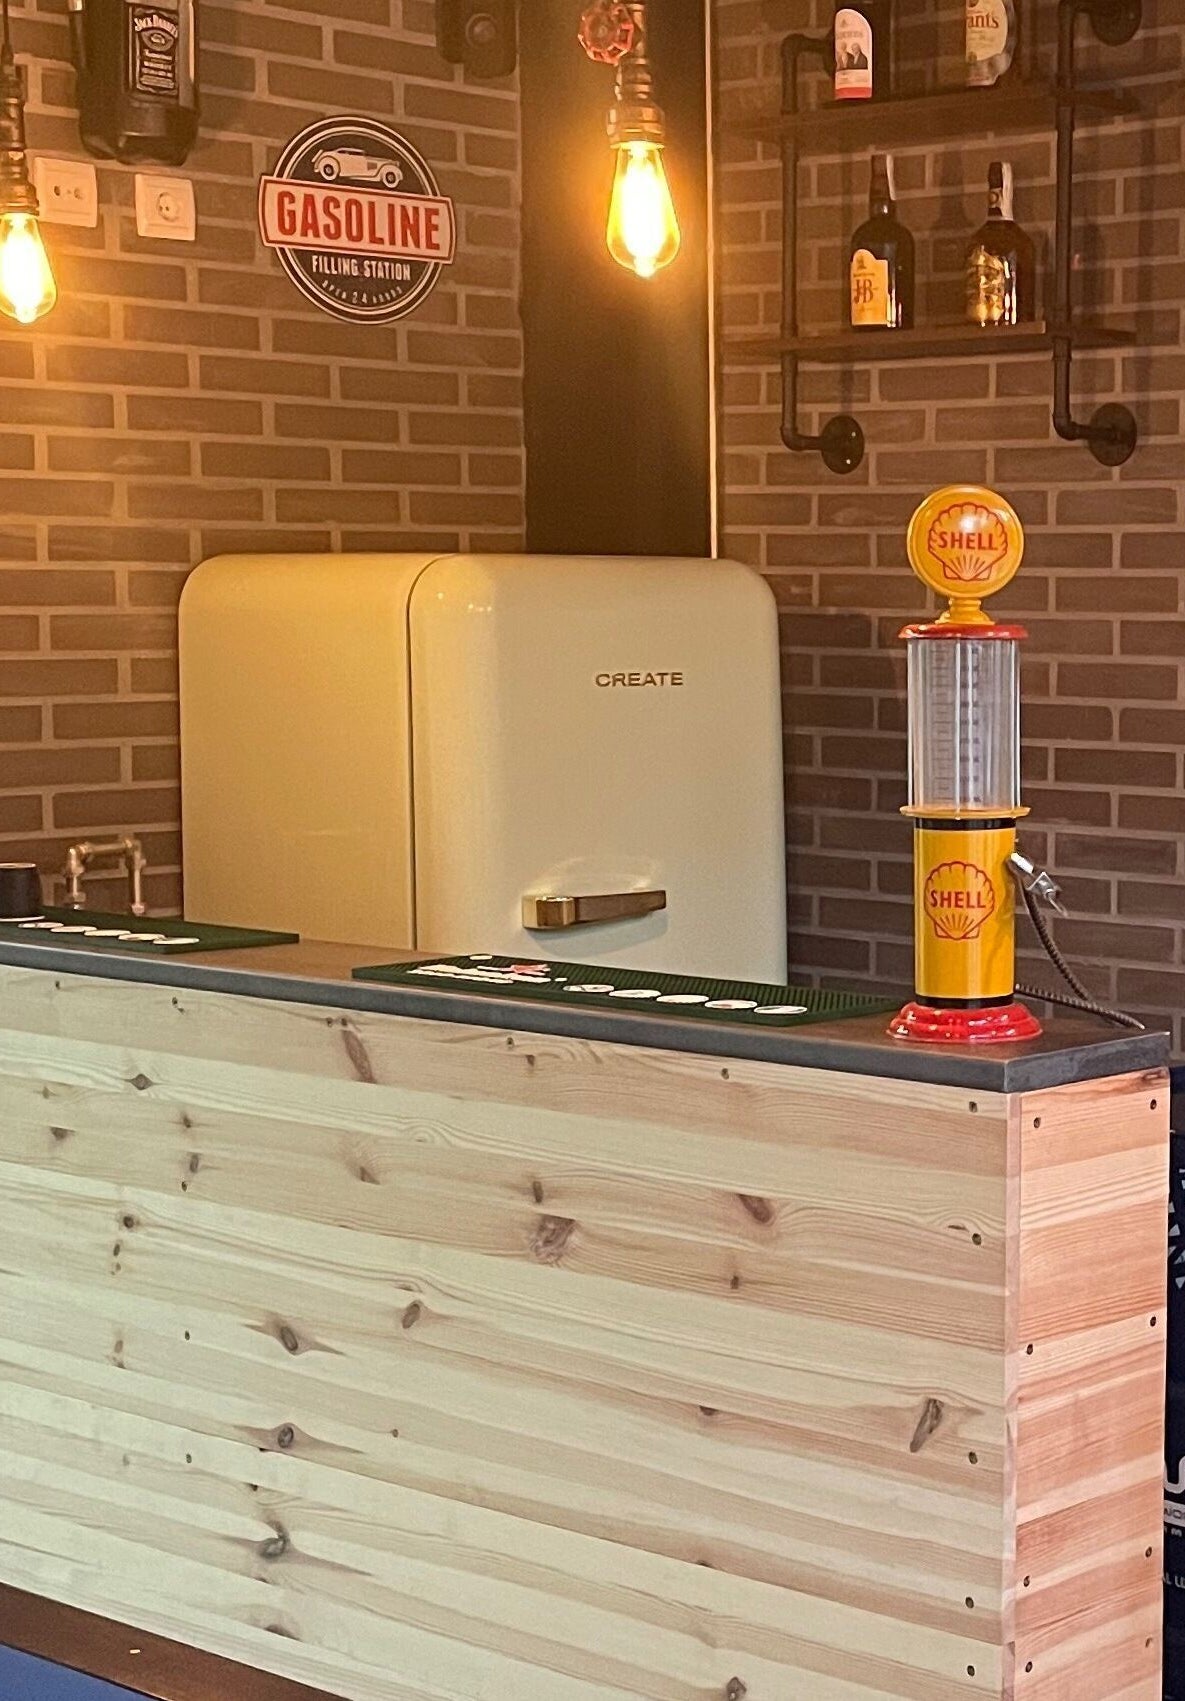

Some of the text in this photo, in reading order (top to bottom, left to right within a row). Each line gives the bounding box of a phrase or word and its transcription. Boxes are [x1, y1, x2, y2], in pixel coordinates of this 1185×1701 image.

[277, 191, 441, 251] GASOLINE
[312, 255, 411, 281] FILLING STATION
[938, 531, 998, 551] SHELL
[595, 672, 684, 687] CREATE
[930, 890, 986, 908] SHELL
